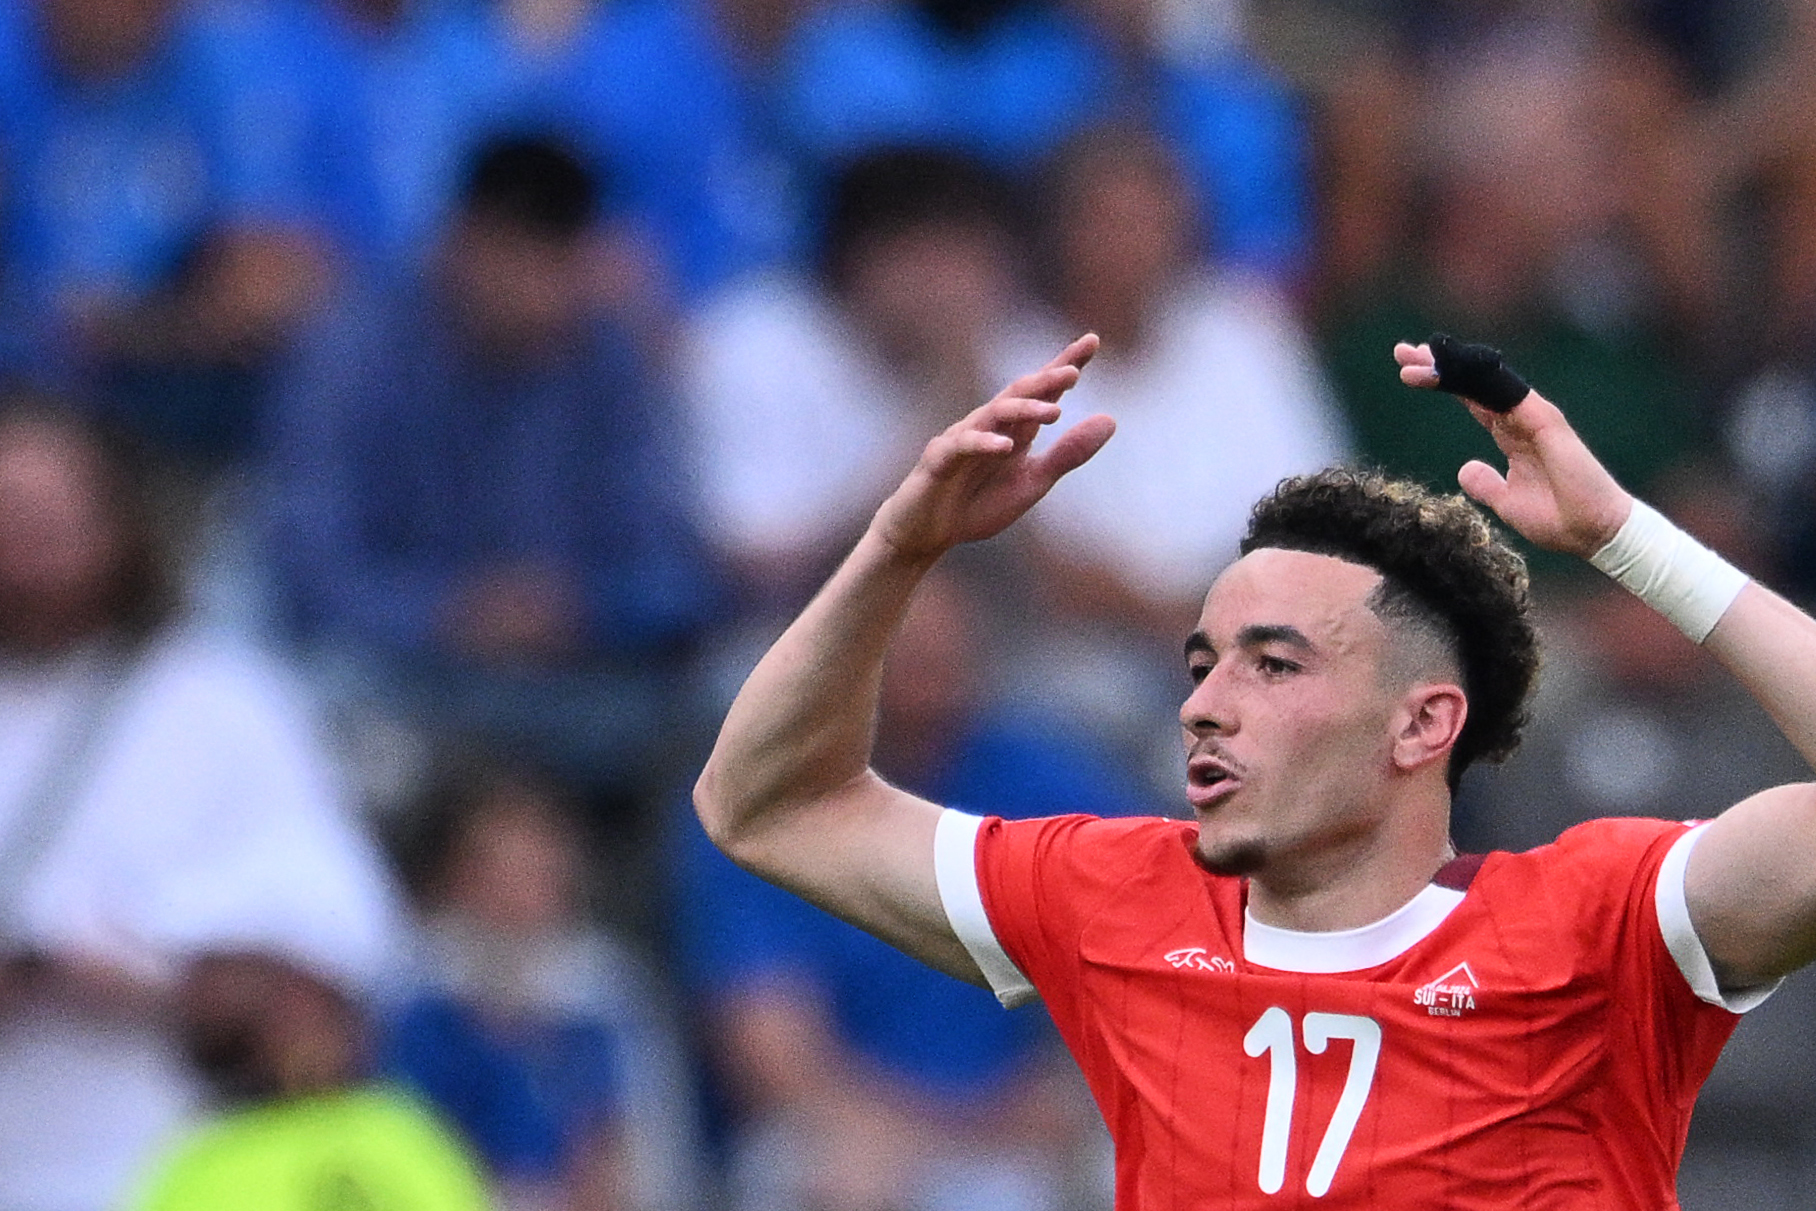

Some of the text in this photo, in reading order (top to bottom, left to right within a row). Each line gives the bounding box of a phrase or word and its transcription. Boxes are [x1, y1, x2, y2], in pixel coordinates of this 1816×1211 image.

[1413, 988, 1436, 1006] SUI
[1452, 993, 1475, 1010] ITA
[1428, 1006, 1461, 1017] BERLIN
[1243, 1006, 1382, 1198] 17
